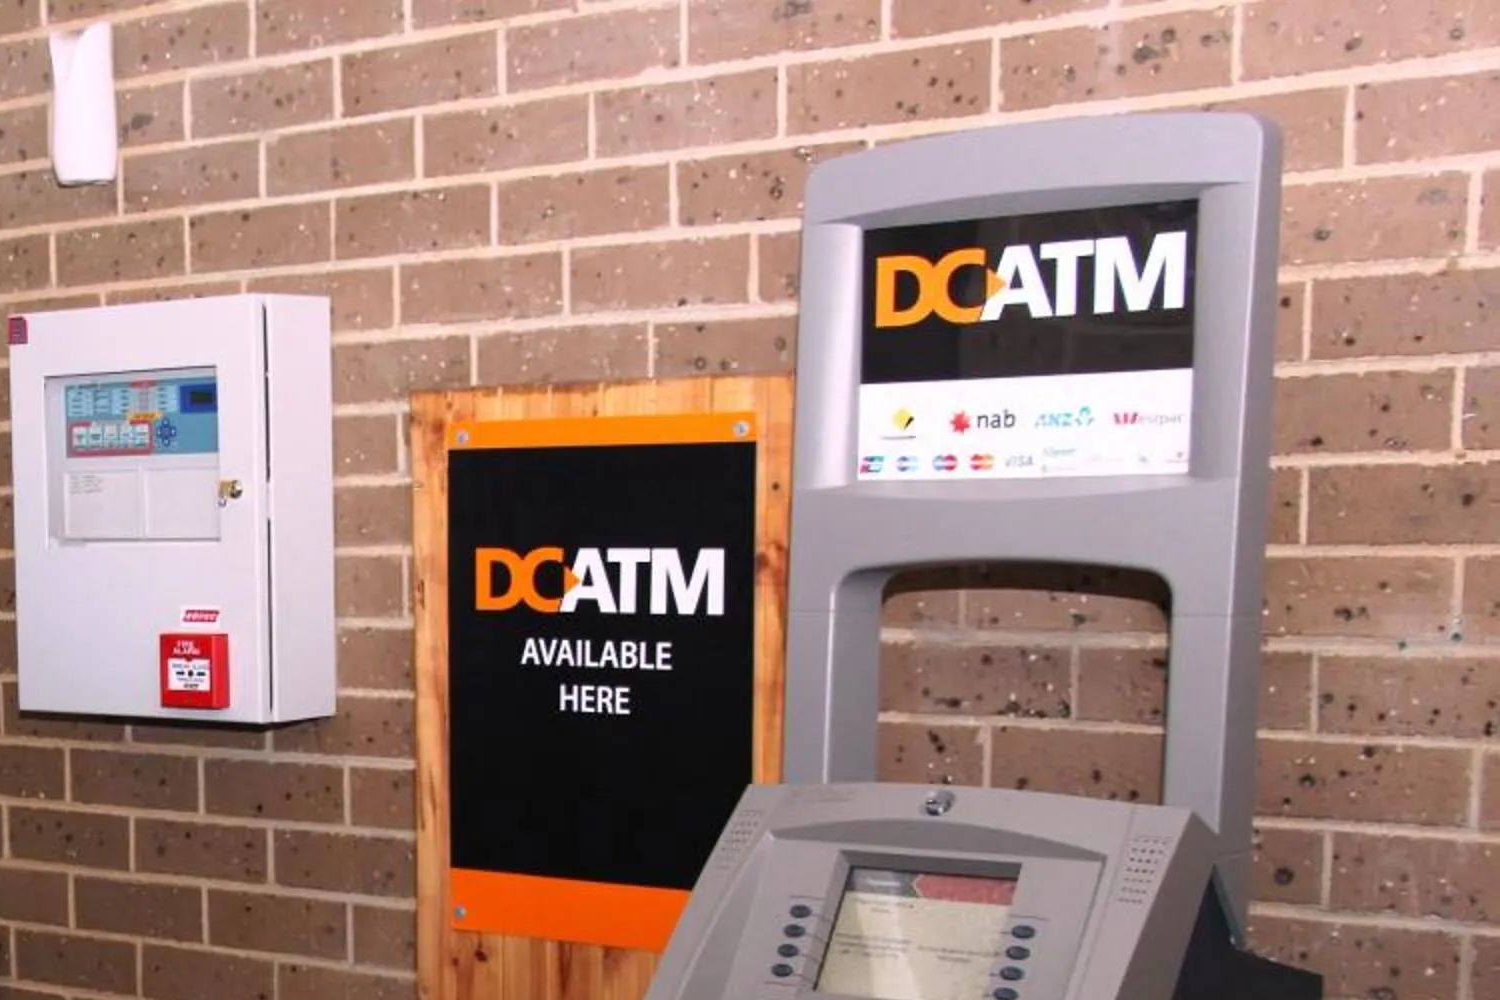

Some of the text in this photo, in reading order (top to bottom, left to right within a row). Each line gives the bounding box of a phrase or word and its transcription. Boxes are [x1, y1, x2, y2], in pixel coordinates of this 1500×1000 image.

[875, 231, 1187, 328] DCATM
[976, 408, 1016, 430] nab
[1034, 411, 1073, 428] ANZ
[1004, 455, 1034, 468] VISA
[475, 547, 725, 615] DCATM
[520, 637, 673, 671] AVAILABLE
[559, 684, 631, 715] HERE
